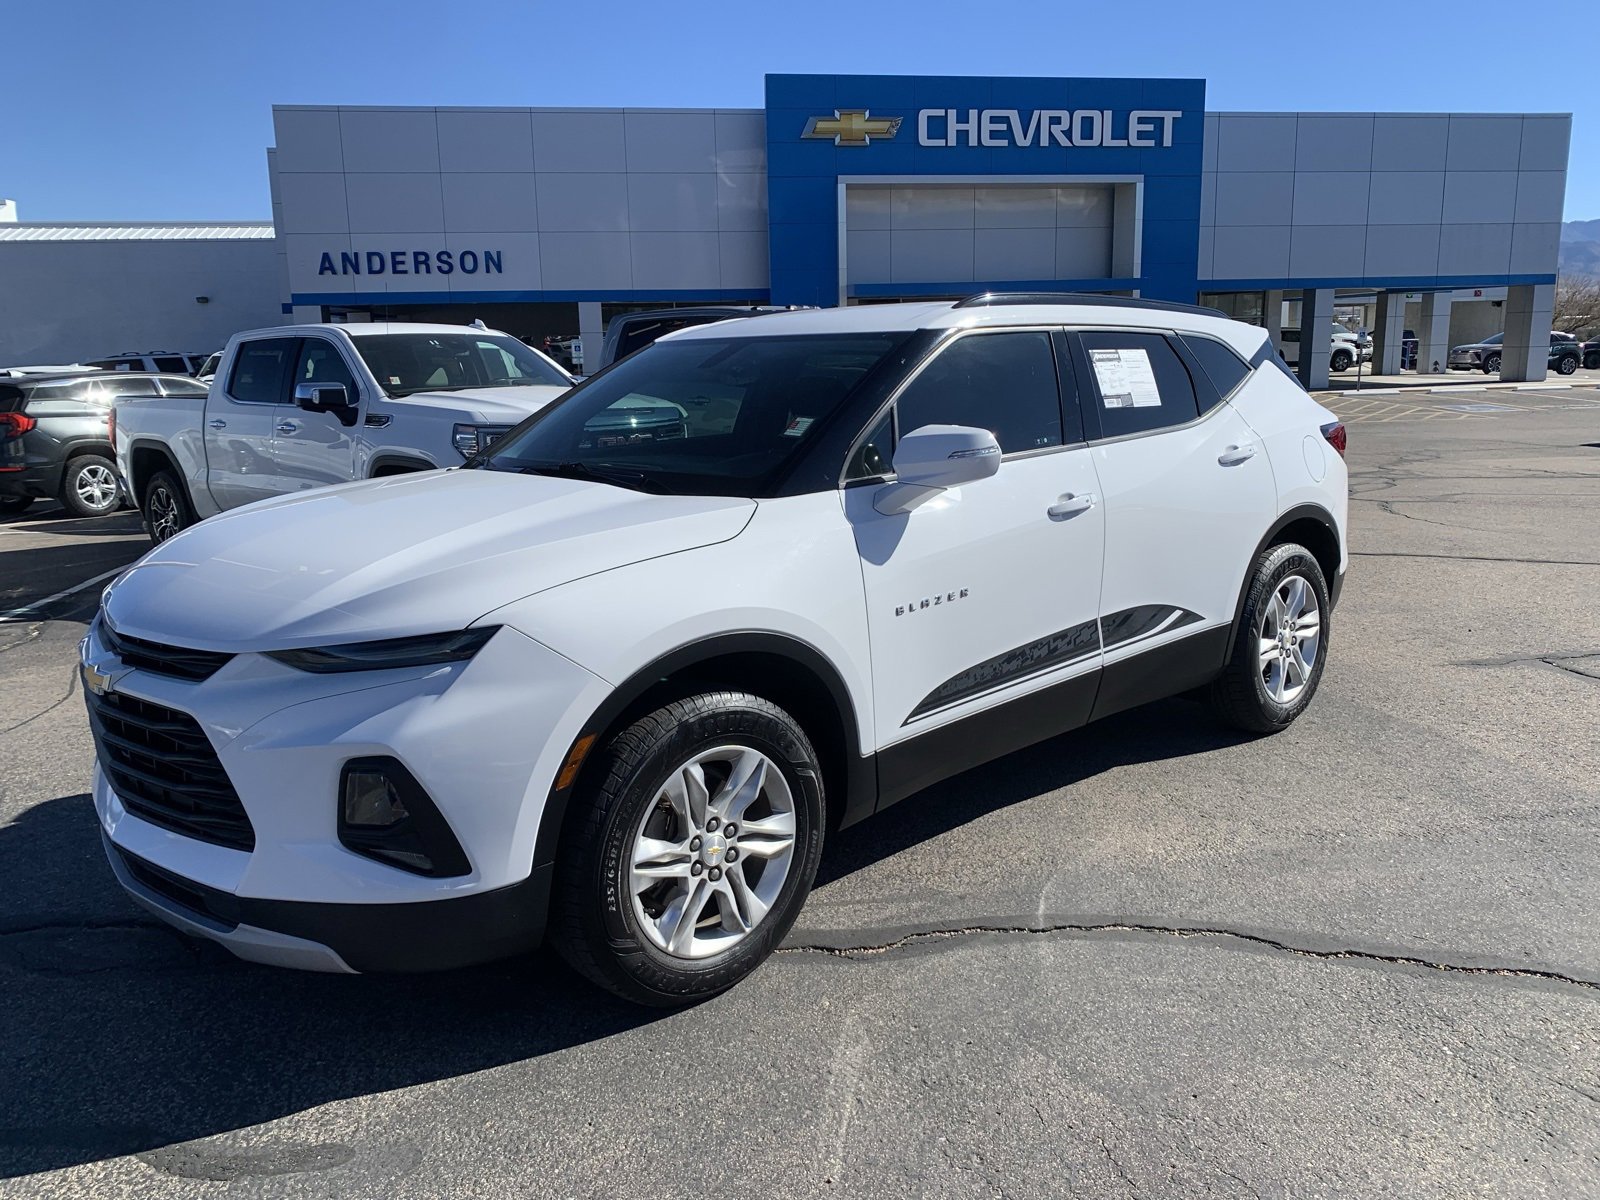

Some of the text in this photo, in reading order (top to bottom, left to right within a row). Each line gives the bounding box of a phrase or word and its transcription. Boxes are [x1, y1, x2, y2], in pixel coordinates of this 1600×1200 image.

[918, 108, 1182, 147] CHEVROLET
[318, 250, 503, 276] ANDERSON
[895, 587, 969, 617] BLAZER
